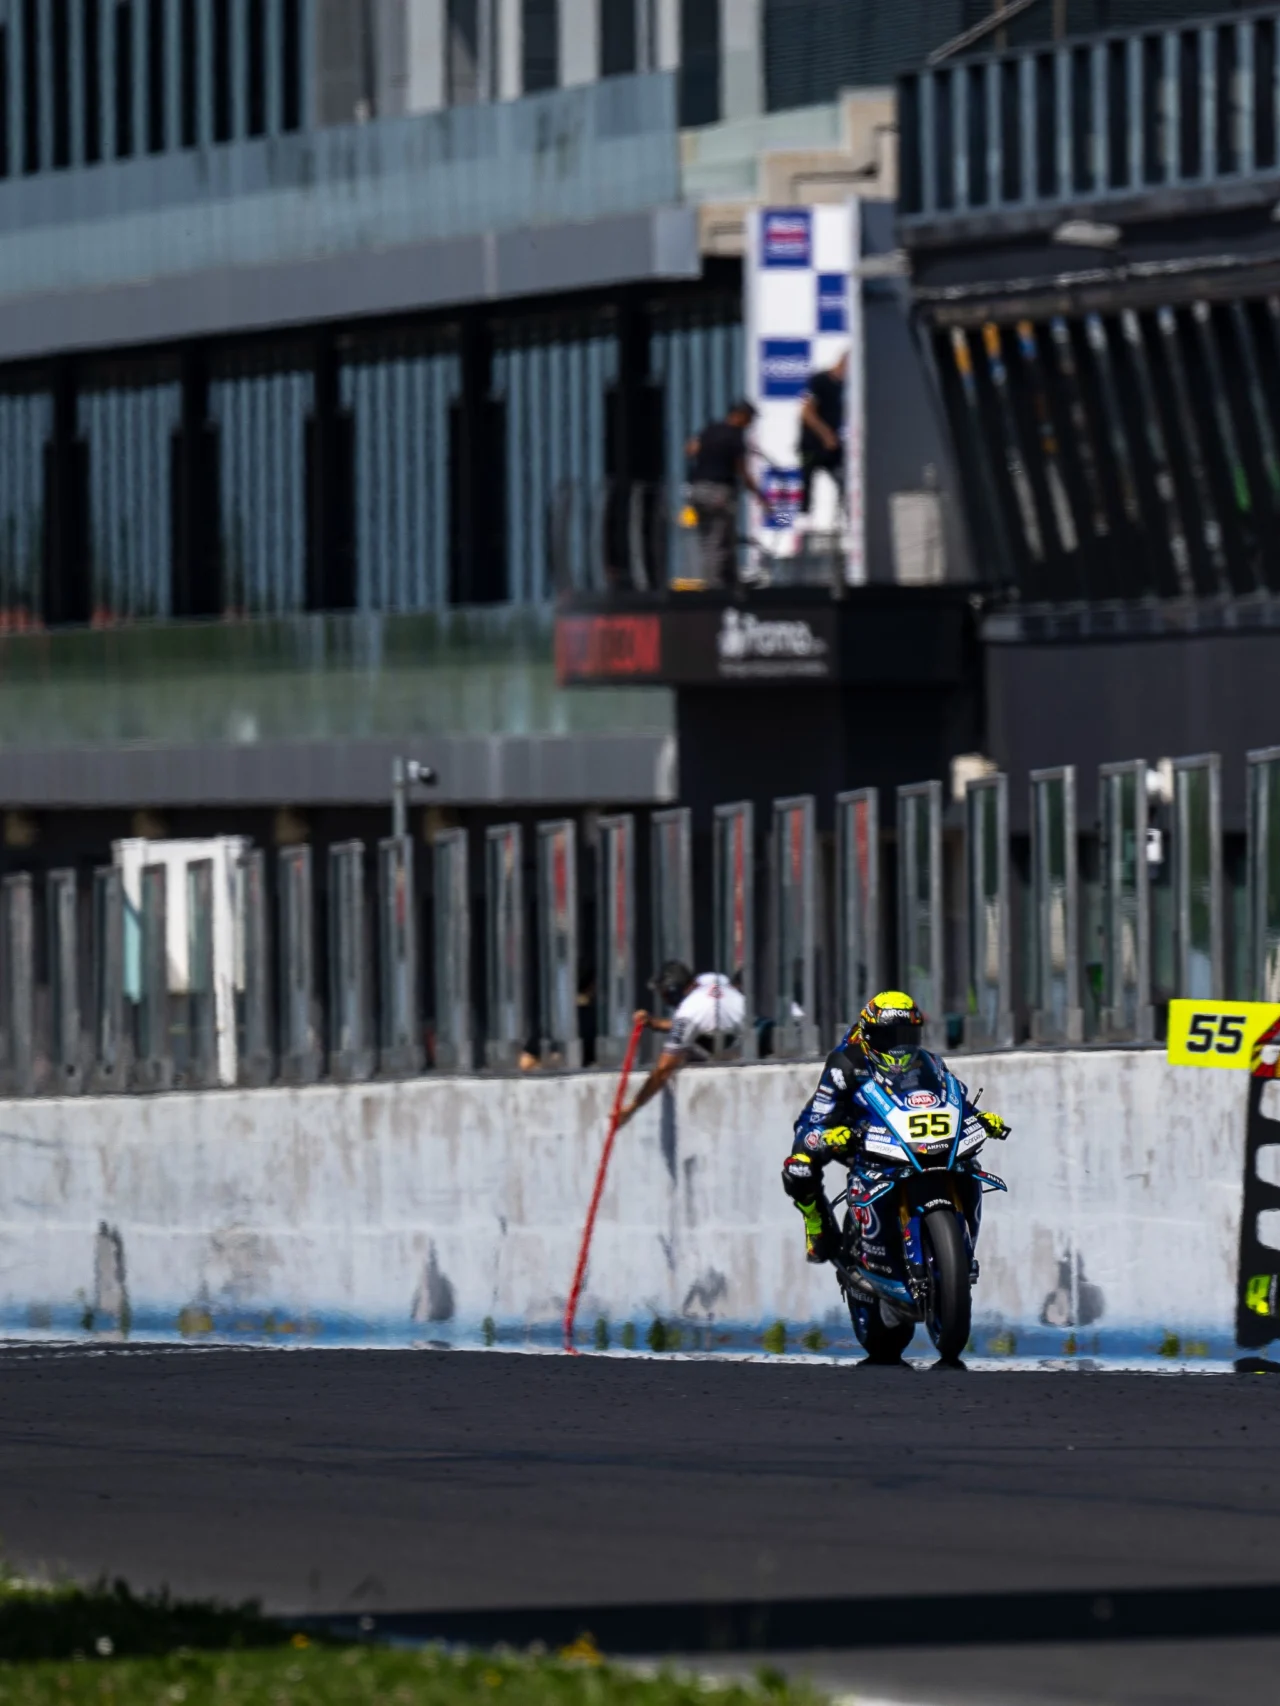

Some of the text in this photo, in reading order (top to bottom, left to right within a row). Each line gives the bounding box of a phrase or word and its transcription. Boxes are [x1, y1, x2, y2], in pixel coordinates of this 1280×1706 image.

[880, 1008, 911, 1018] AIROH
[1186, 1013, 1247, 1055] 55
[908, 1113, 950, 1139] 55
